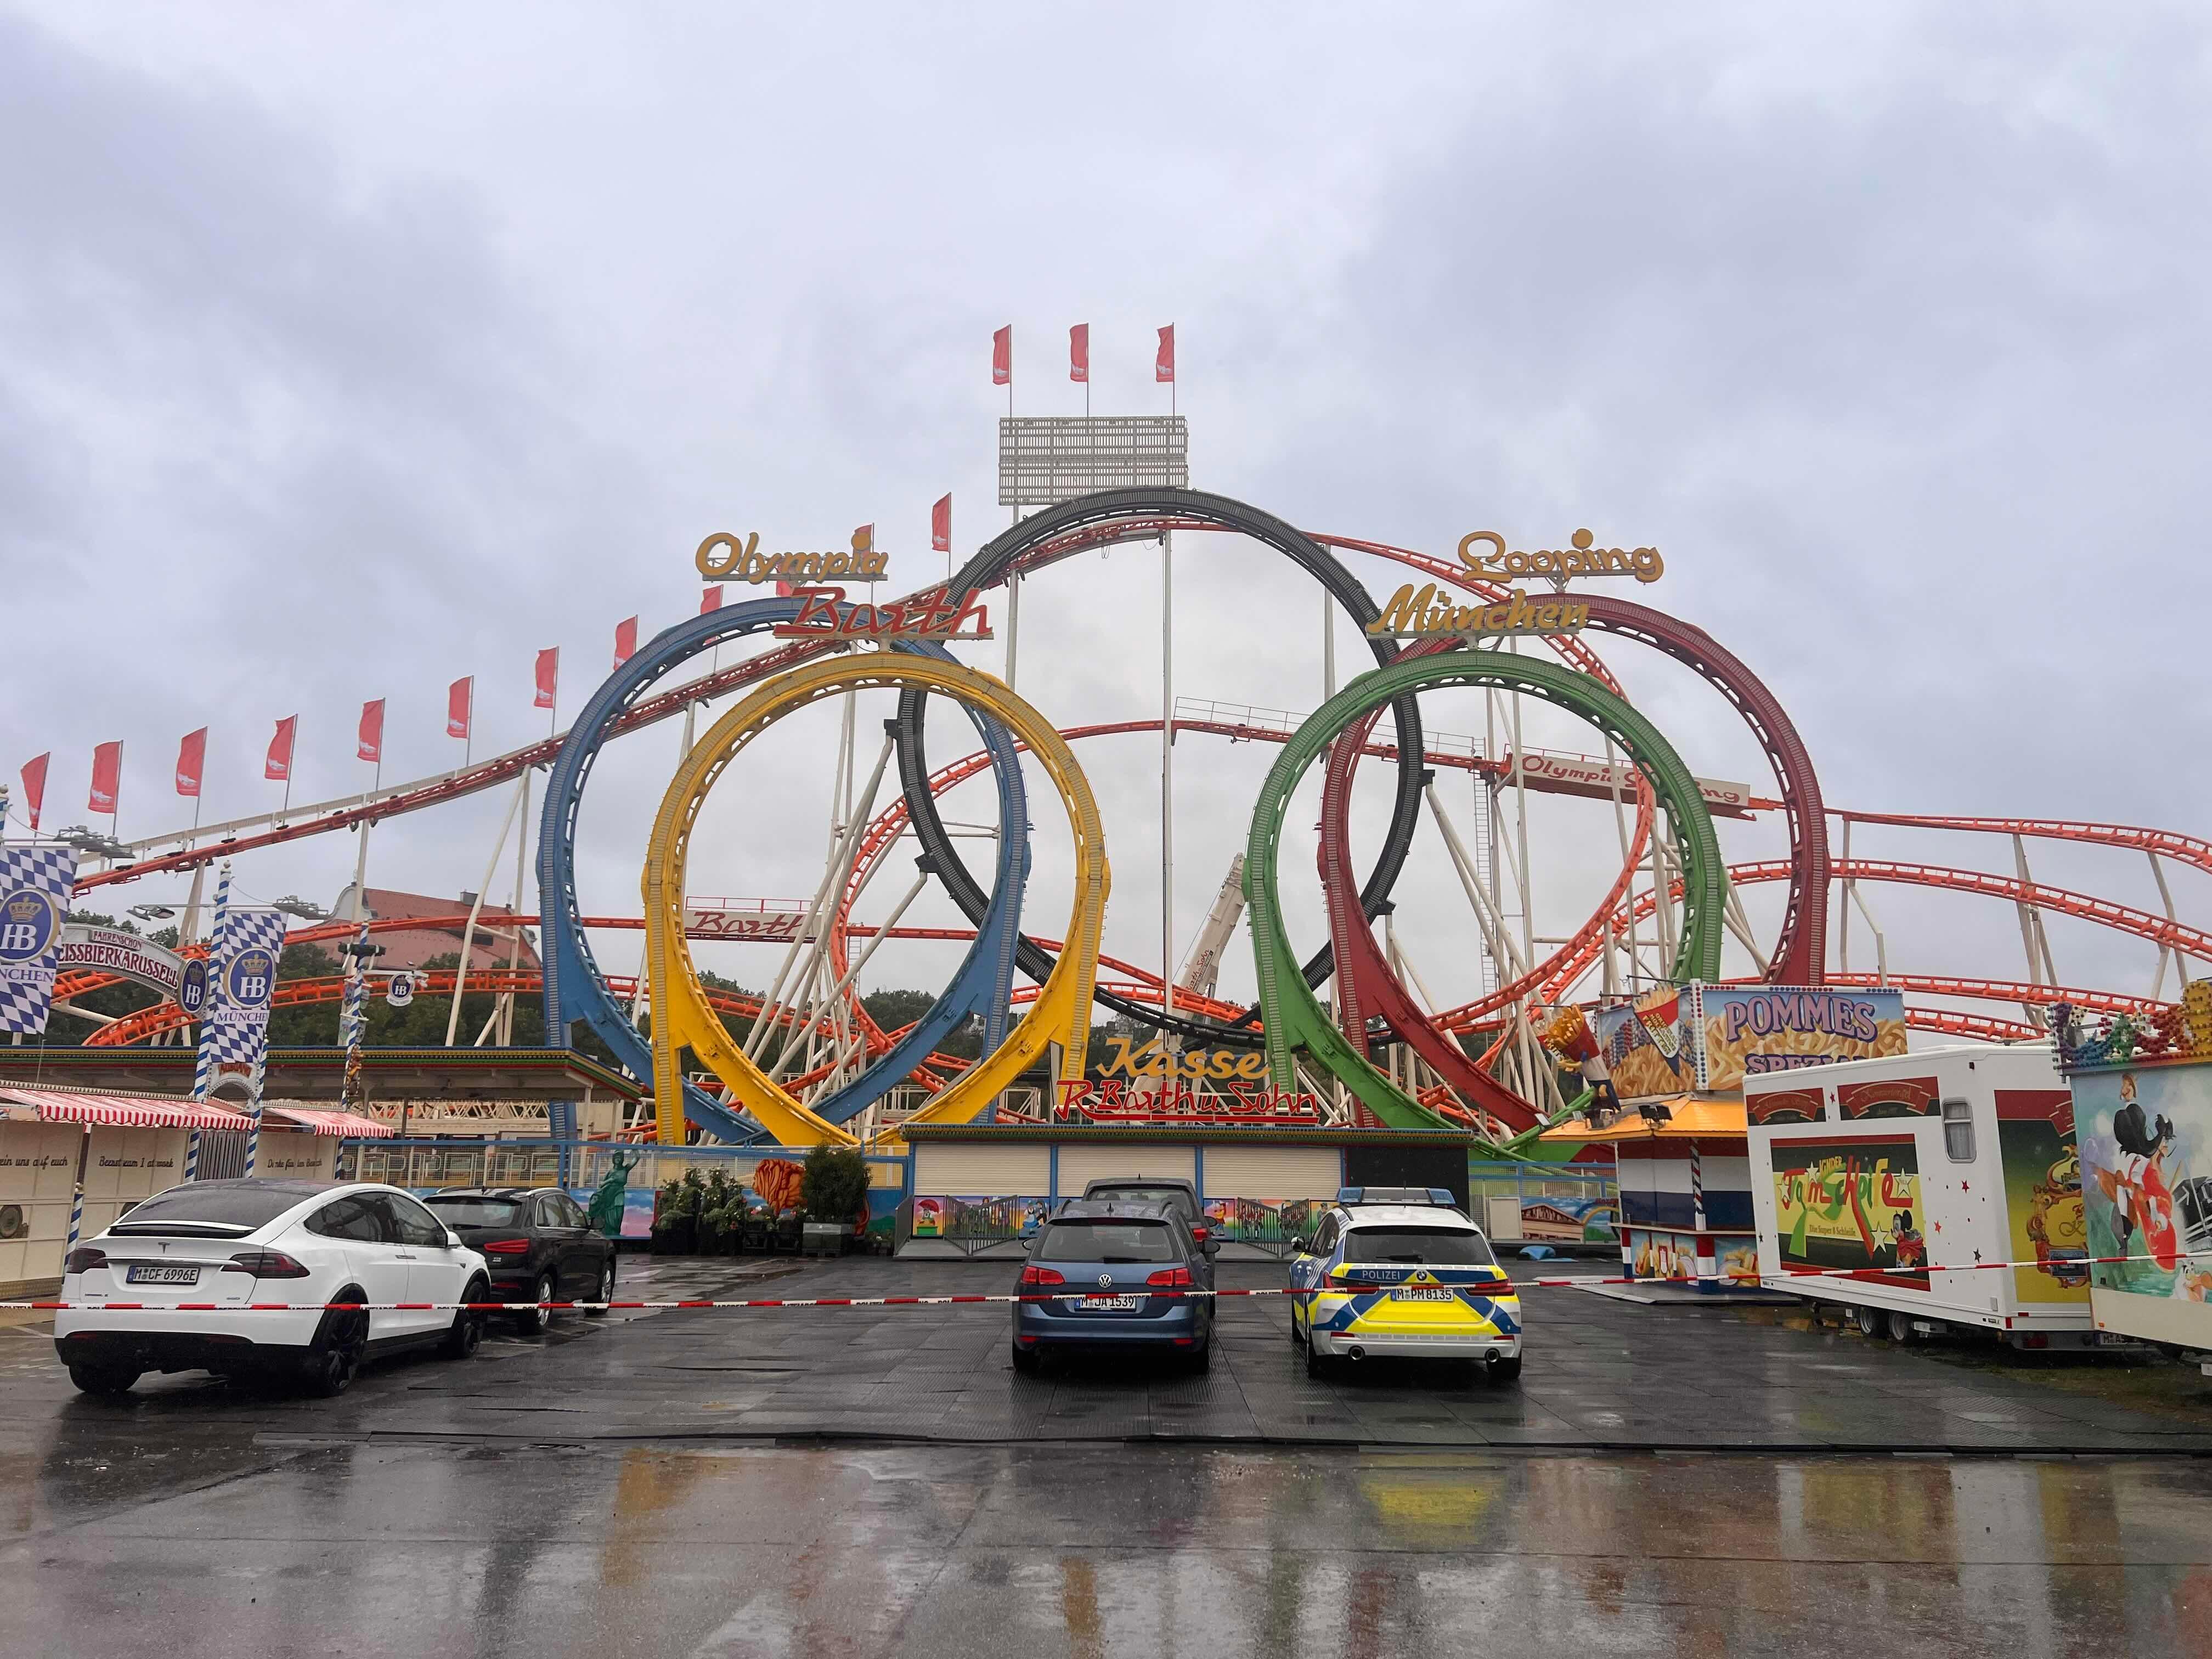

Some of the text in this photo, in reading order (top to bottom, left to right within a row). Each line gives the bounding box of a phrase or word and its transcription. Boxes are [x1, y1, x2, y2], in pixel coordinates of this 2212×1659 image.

[696, 532, 889, 584] Olympia
[1458, 528, 1664, 583] Looping
[774, 586, 993, 636] Barth
[1366, 583, 1589, 633] München
[93, 931, 143, 950] FAHRENSCHON
[239, 977, 266, 998] HB
[217, 1011, 268, 1022] MÜNCHE
[1724, 994, 1878, 1042] POMMES
[1096, 1037, 1273, 1079] Kasse
[134, 1268, 197, 1281] M CF 6996E
[1362, 1270, 1400, 1280] POLIZEI
[1081, 1297, 1088, 1306] M
[1094, 1298, 1107, 1306] JA
[1110, 1297, 1134, 1307] 1539
[1397, 1289, 1403, 1299] M
[1411, 1289, 1424, 1300] PM
[1426, 1290, 1452, 1300] 8135
